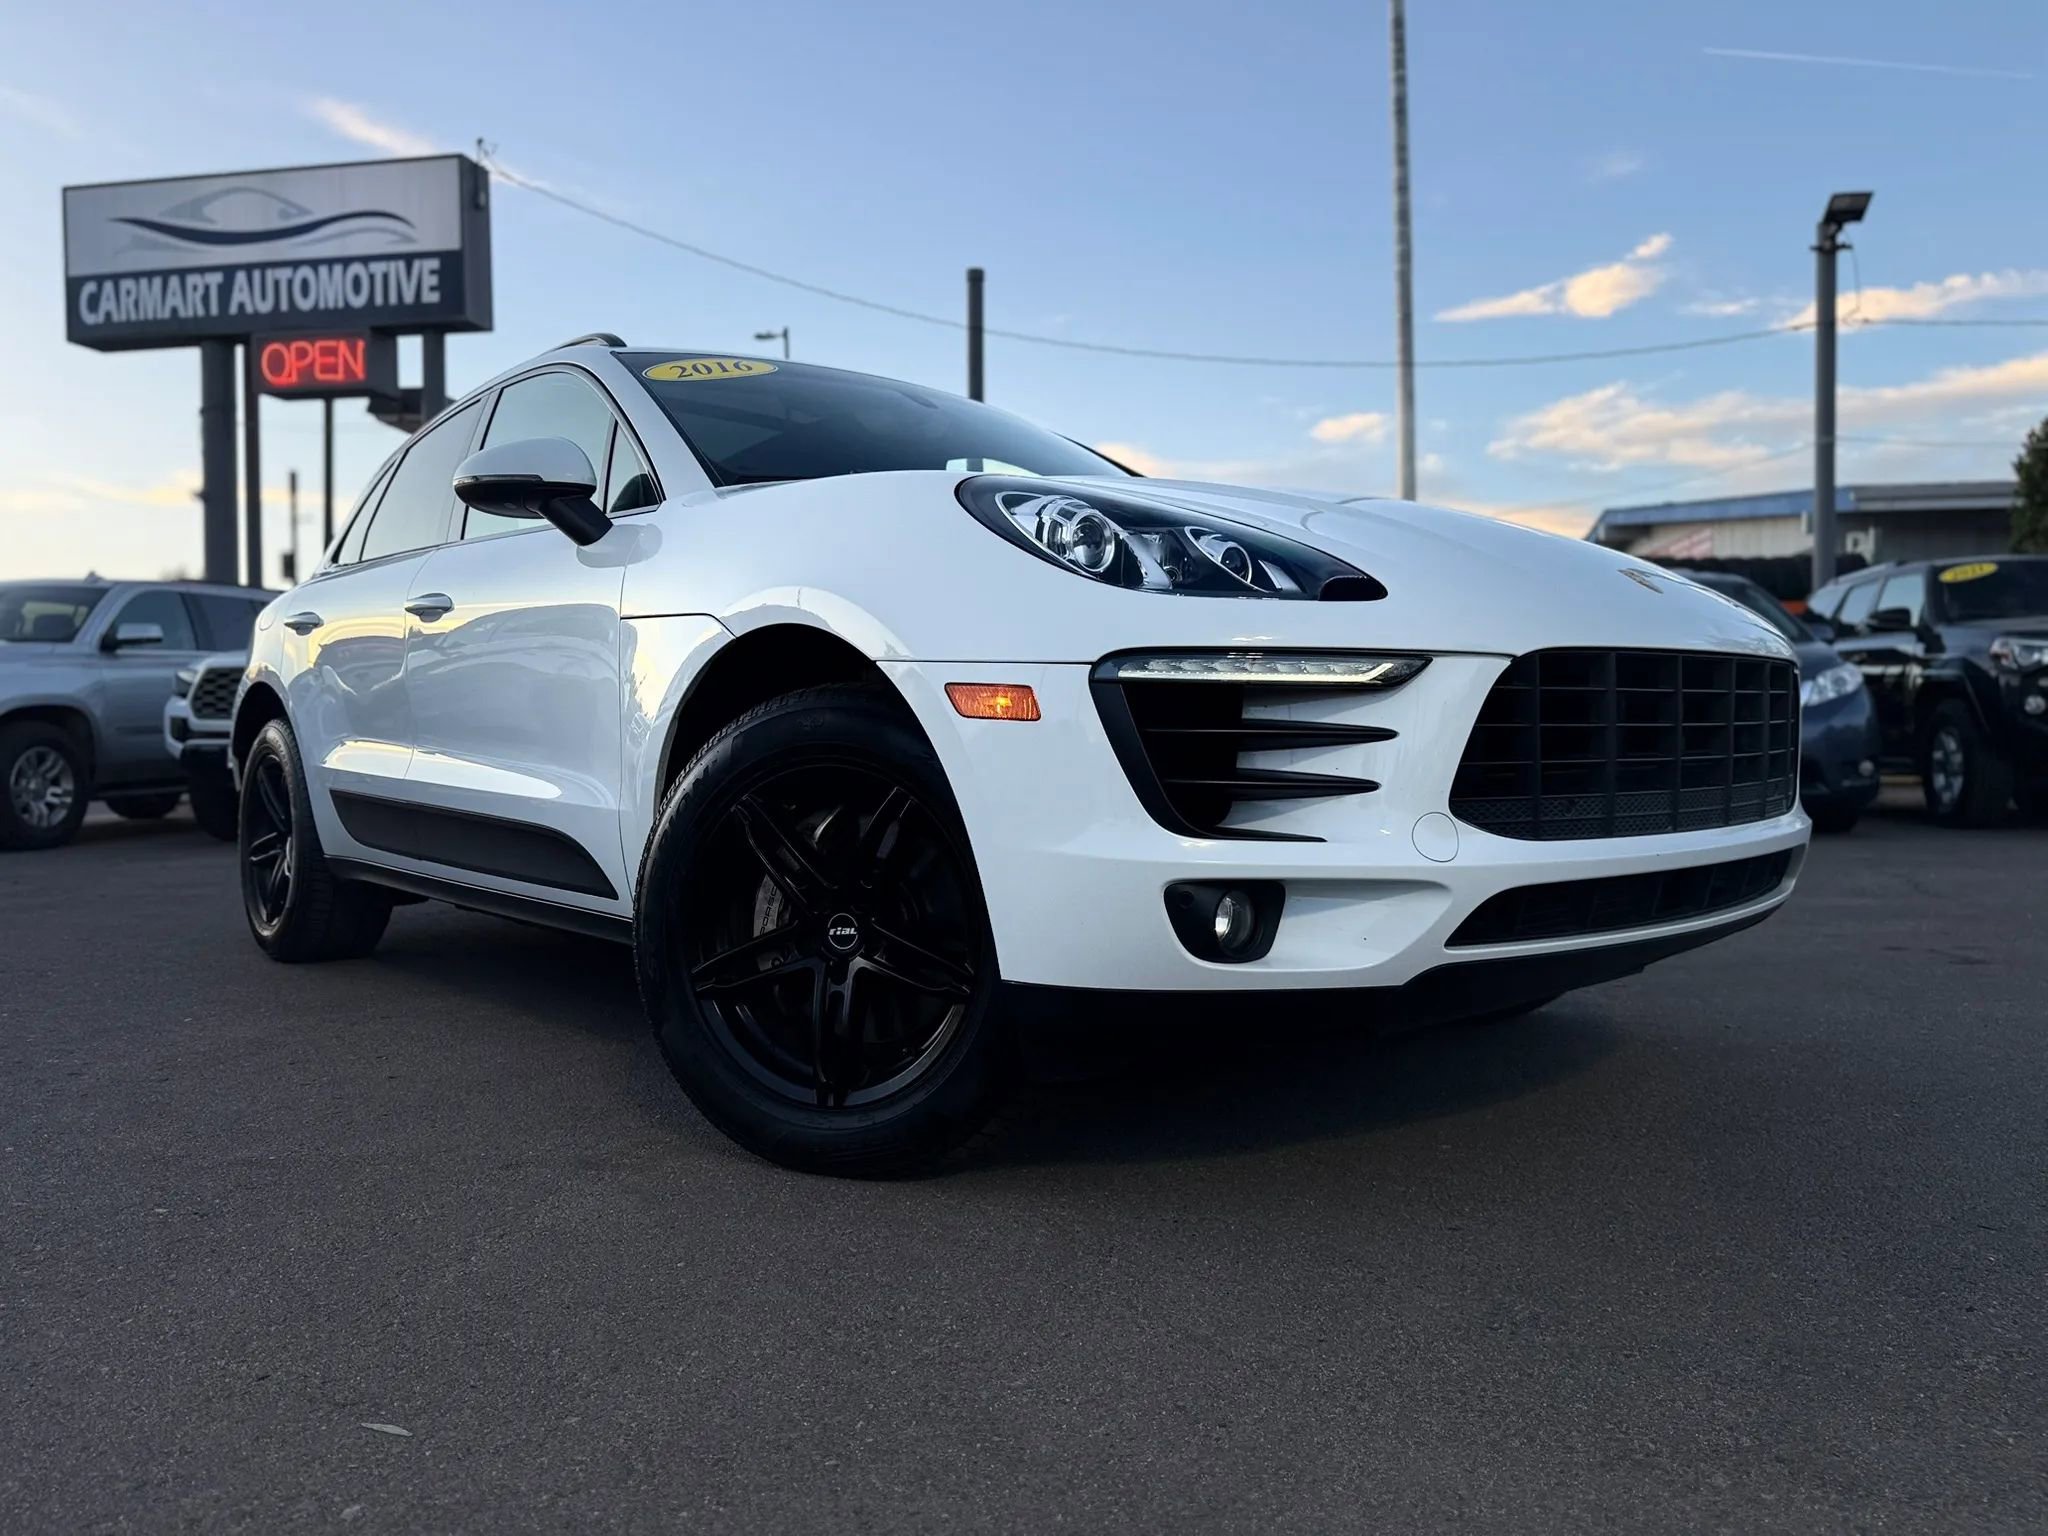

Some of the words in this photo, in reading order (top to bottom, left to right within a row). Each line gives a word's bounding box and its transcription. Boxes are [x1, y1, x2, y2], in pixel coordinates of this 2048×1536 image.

[79, 272, 223, 325] CARMART
[228, 258, 441, 315] AUTOMOTIVE
[261, 339, 365, 387] OPEN
[669, 361, 753, 379] 2016
[760, 886, 777, 935] PORSC
